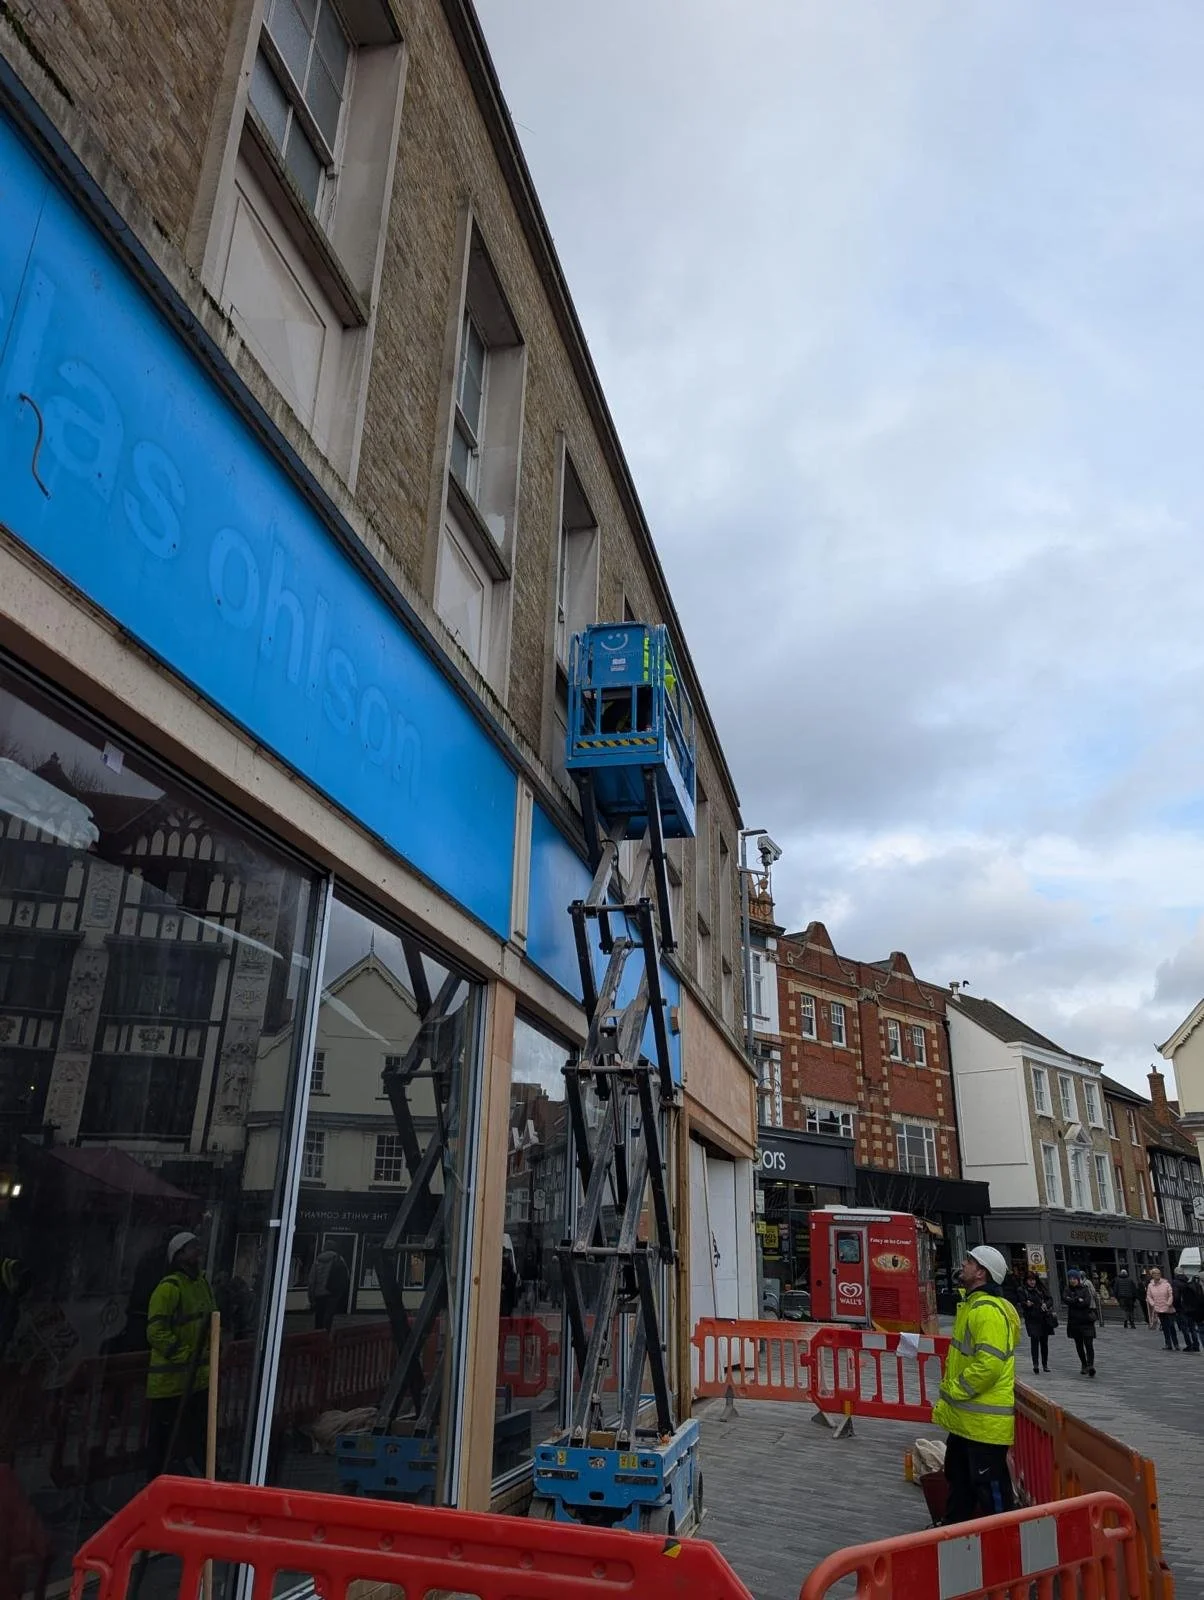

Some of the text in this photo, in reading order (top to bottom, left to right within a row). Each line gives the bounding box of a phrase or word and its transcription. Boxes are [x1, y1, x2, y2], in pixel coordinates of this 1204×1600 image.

[0, 265, 423, 801] las ohlson
[839, 1297, 863, 1306] WALL'S
